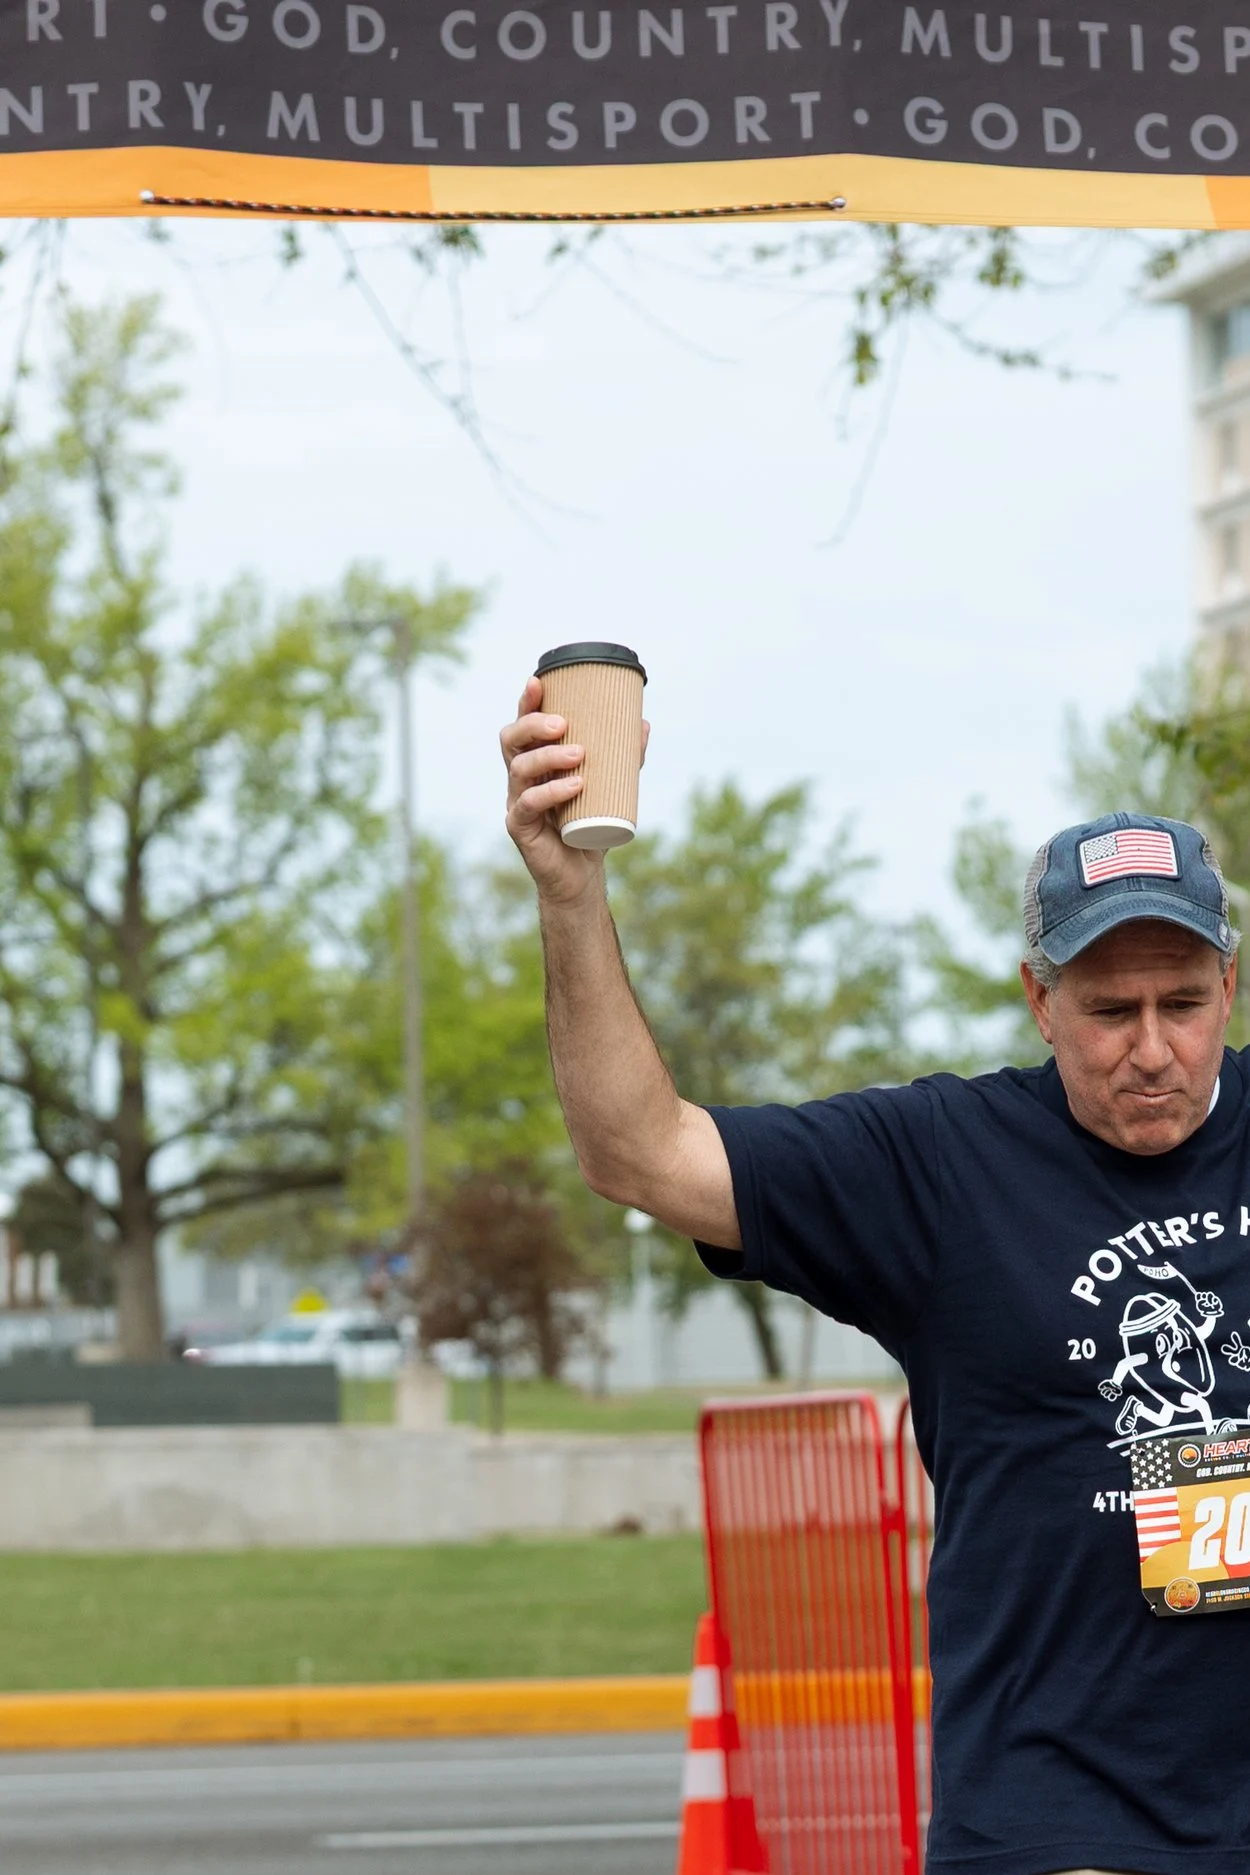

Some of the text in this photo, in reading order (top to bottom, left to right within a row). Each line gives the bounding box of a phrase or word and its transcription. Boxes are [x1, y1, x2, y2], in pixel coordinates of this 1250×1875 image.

[205, 0, 400, 61] GOD,
[440, 3, 864, 60] COUNTRY,
[266, 90, 824, 150] MULTISPORT
[903, 95, 1098, 160] GOD,
[1070, 1212, 1225, 1307] POTTER'S
[1067, 1339, 1096, 1360] 20
[1092, 1490, 1135, 1513] 4TH
